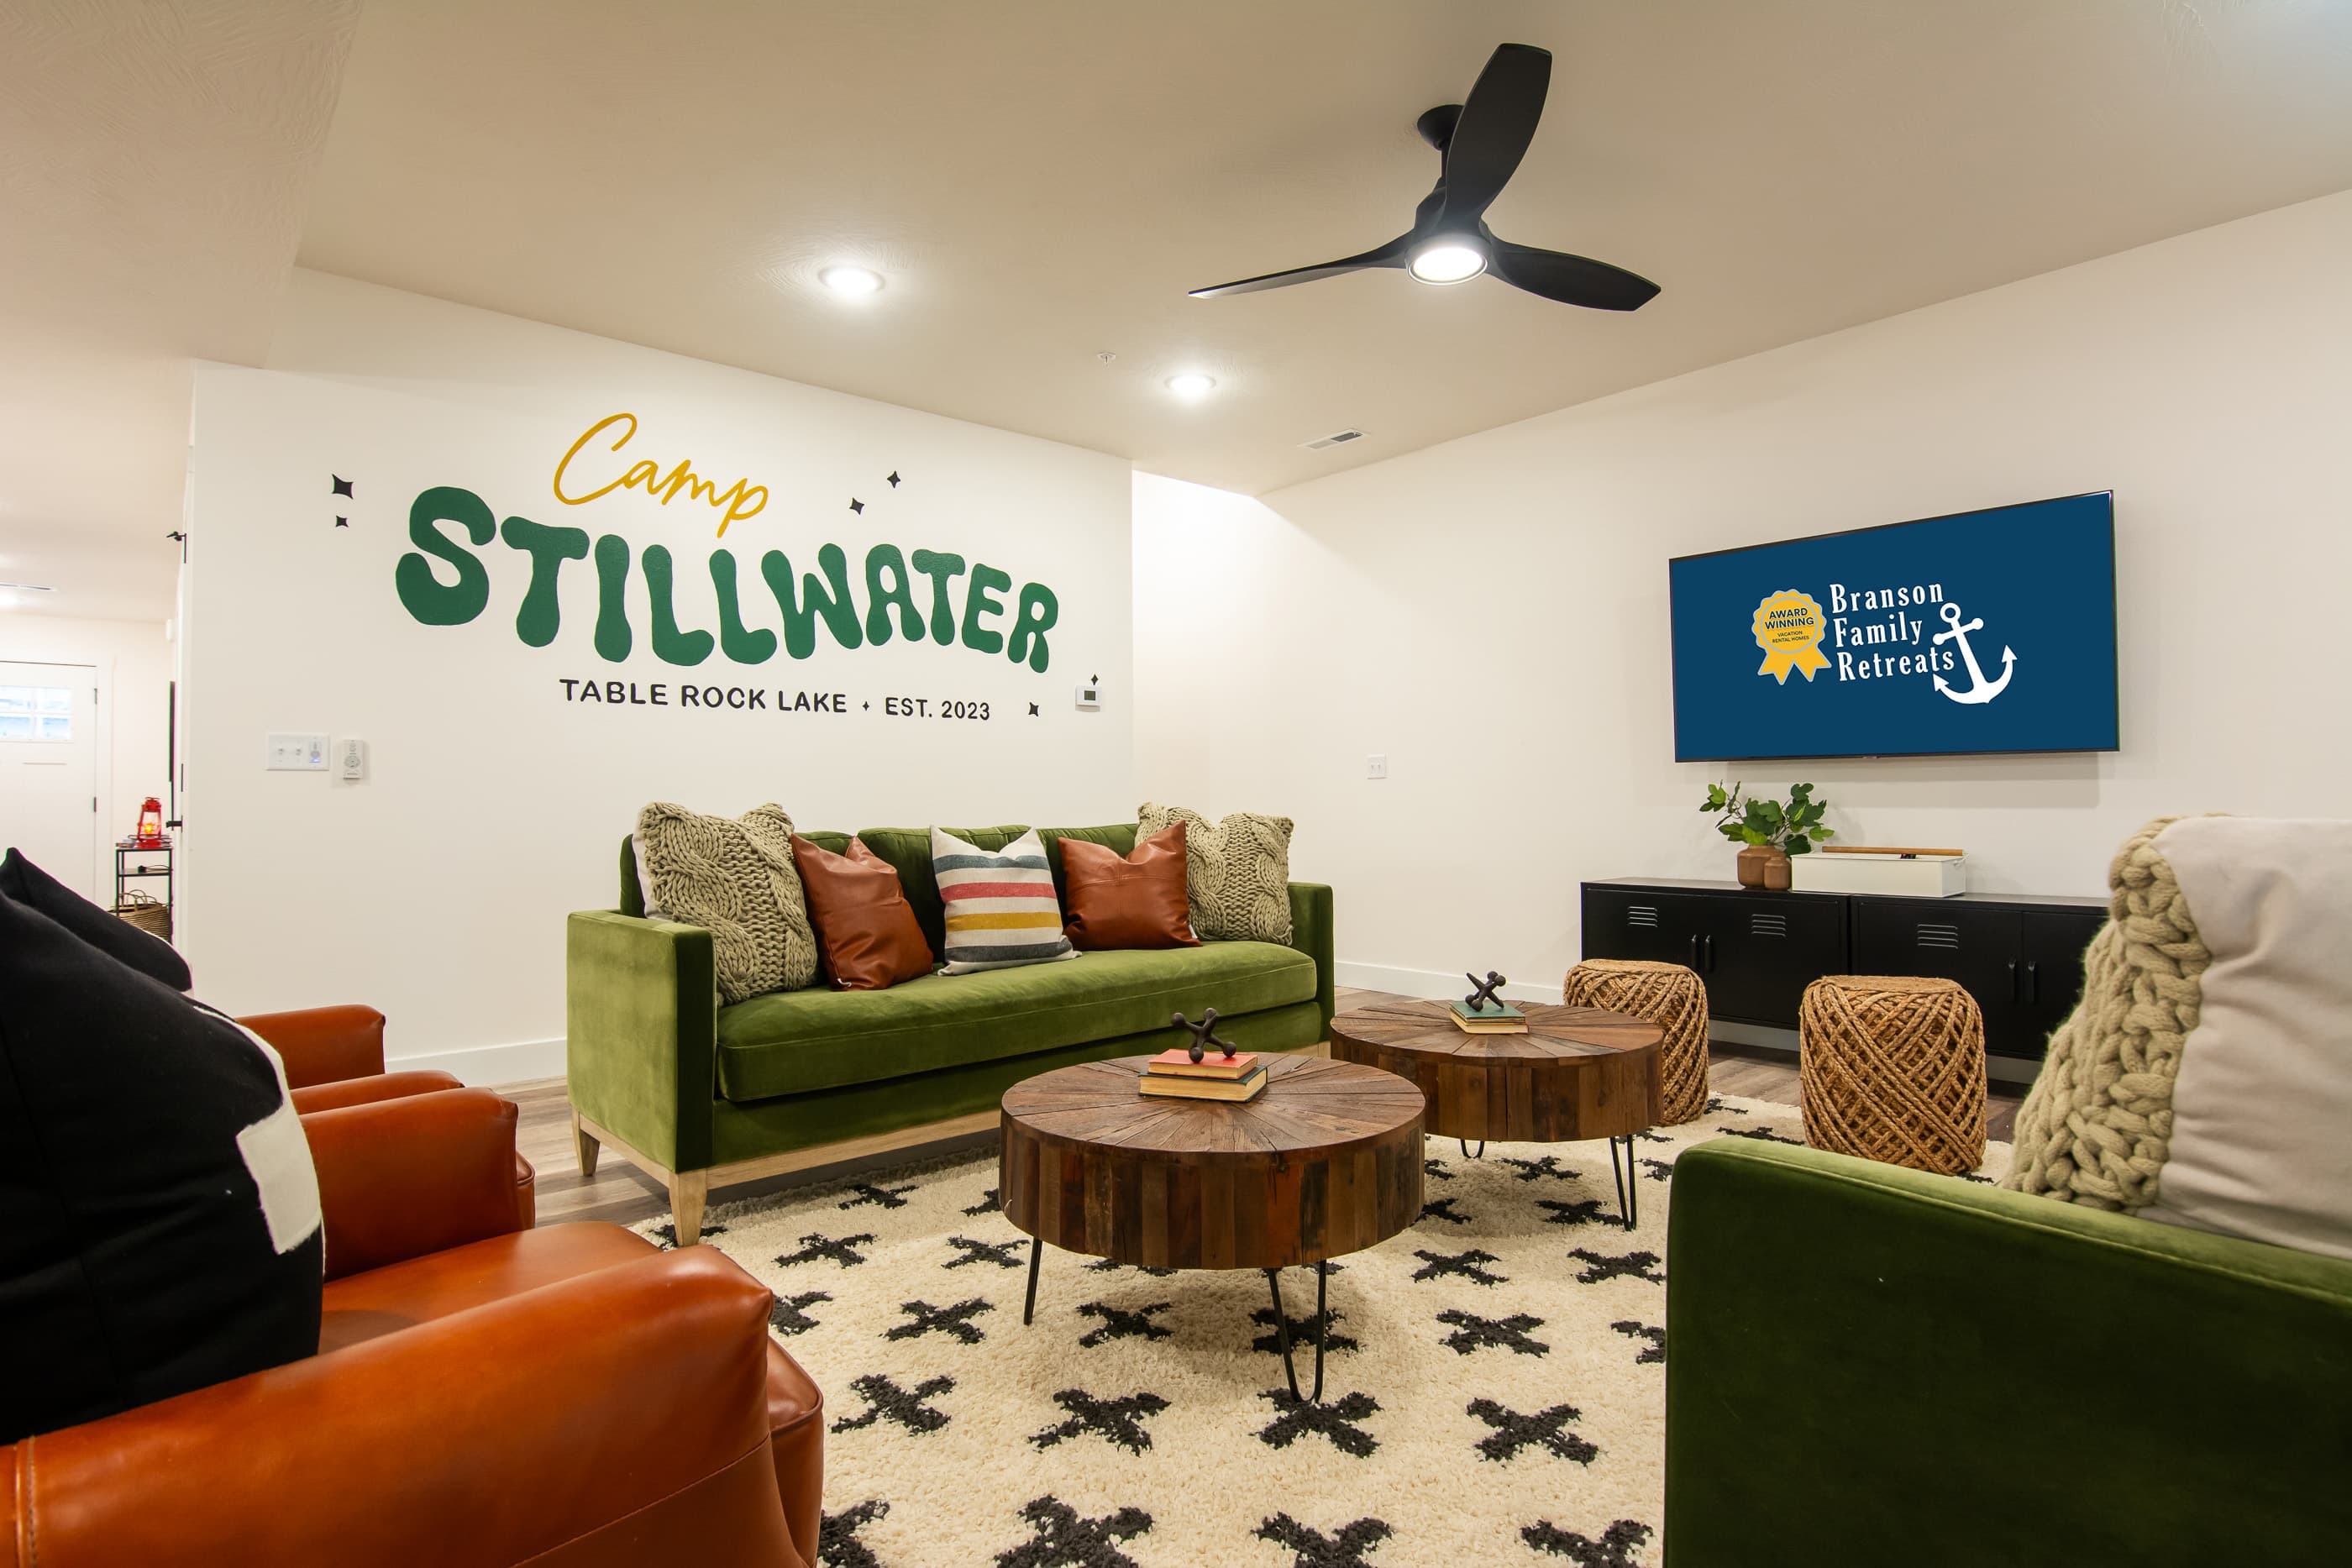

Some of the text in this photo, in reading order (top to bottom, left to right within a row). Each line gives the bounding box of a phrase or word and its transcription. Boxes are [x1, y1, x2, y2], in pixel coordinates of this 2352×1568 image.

[554, 412, 769, 538] Camp
[395, 485, 1059, 674] STILLWATER
[1769, 607, 1808, 619] AWARD
[1830, 583, 1944, 614] Branson
[1765, 617, 1814, 629] WINNING
[1833, 611, 1923, 648] Family
[1836, 646, 1955, 682] Retreats
[559, 679, 990, 721] TABLE ROCK LAKE EST. 2023
